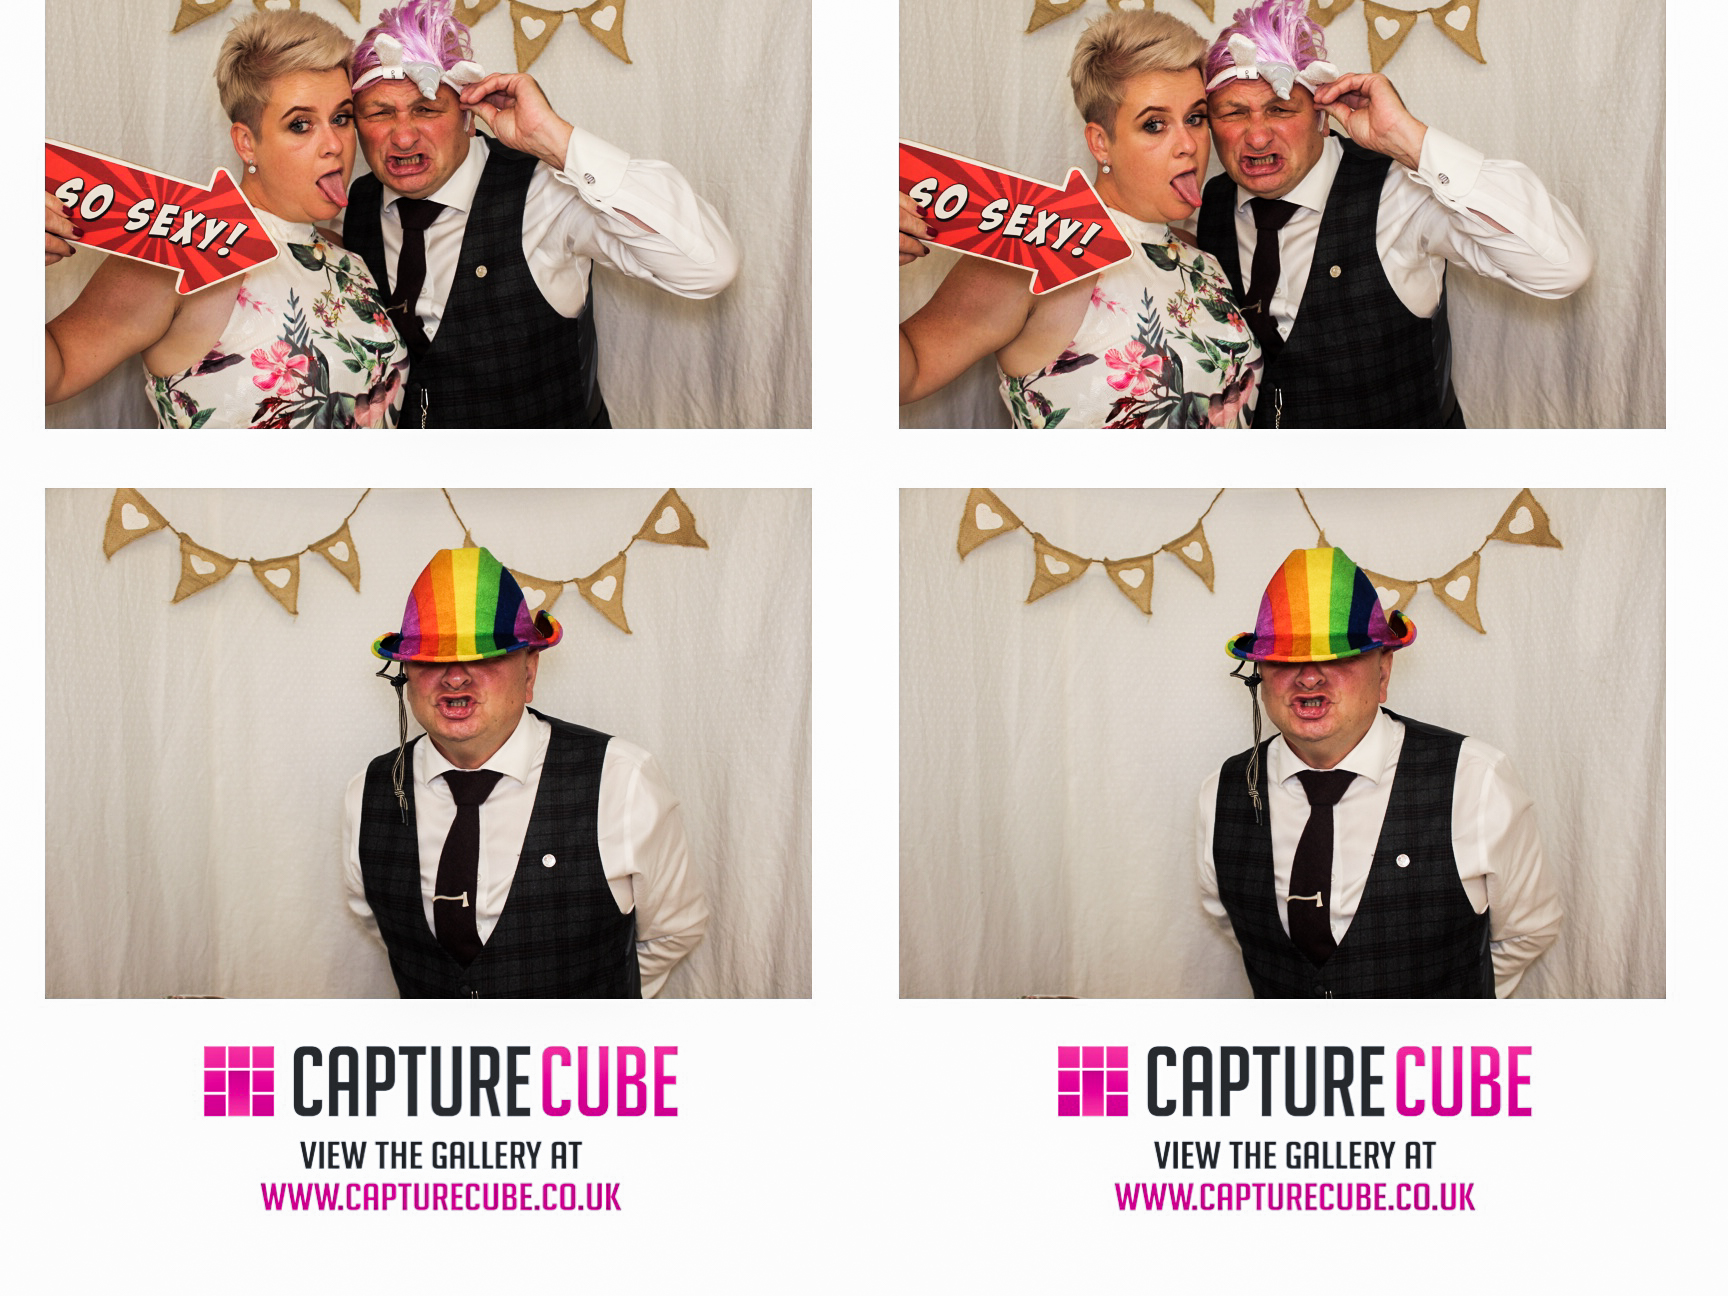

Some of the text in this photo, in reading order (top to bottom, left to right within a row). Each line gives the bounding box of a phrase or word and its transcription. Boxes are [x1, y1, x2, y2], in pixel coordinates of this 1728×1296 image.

[55, 177, 249, 258] SO SEXY!
[909, 177, 1103, 258] SO SEXY!
